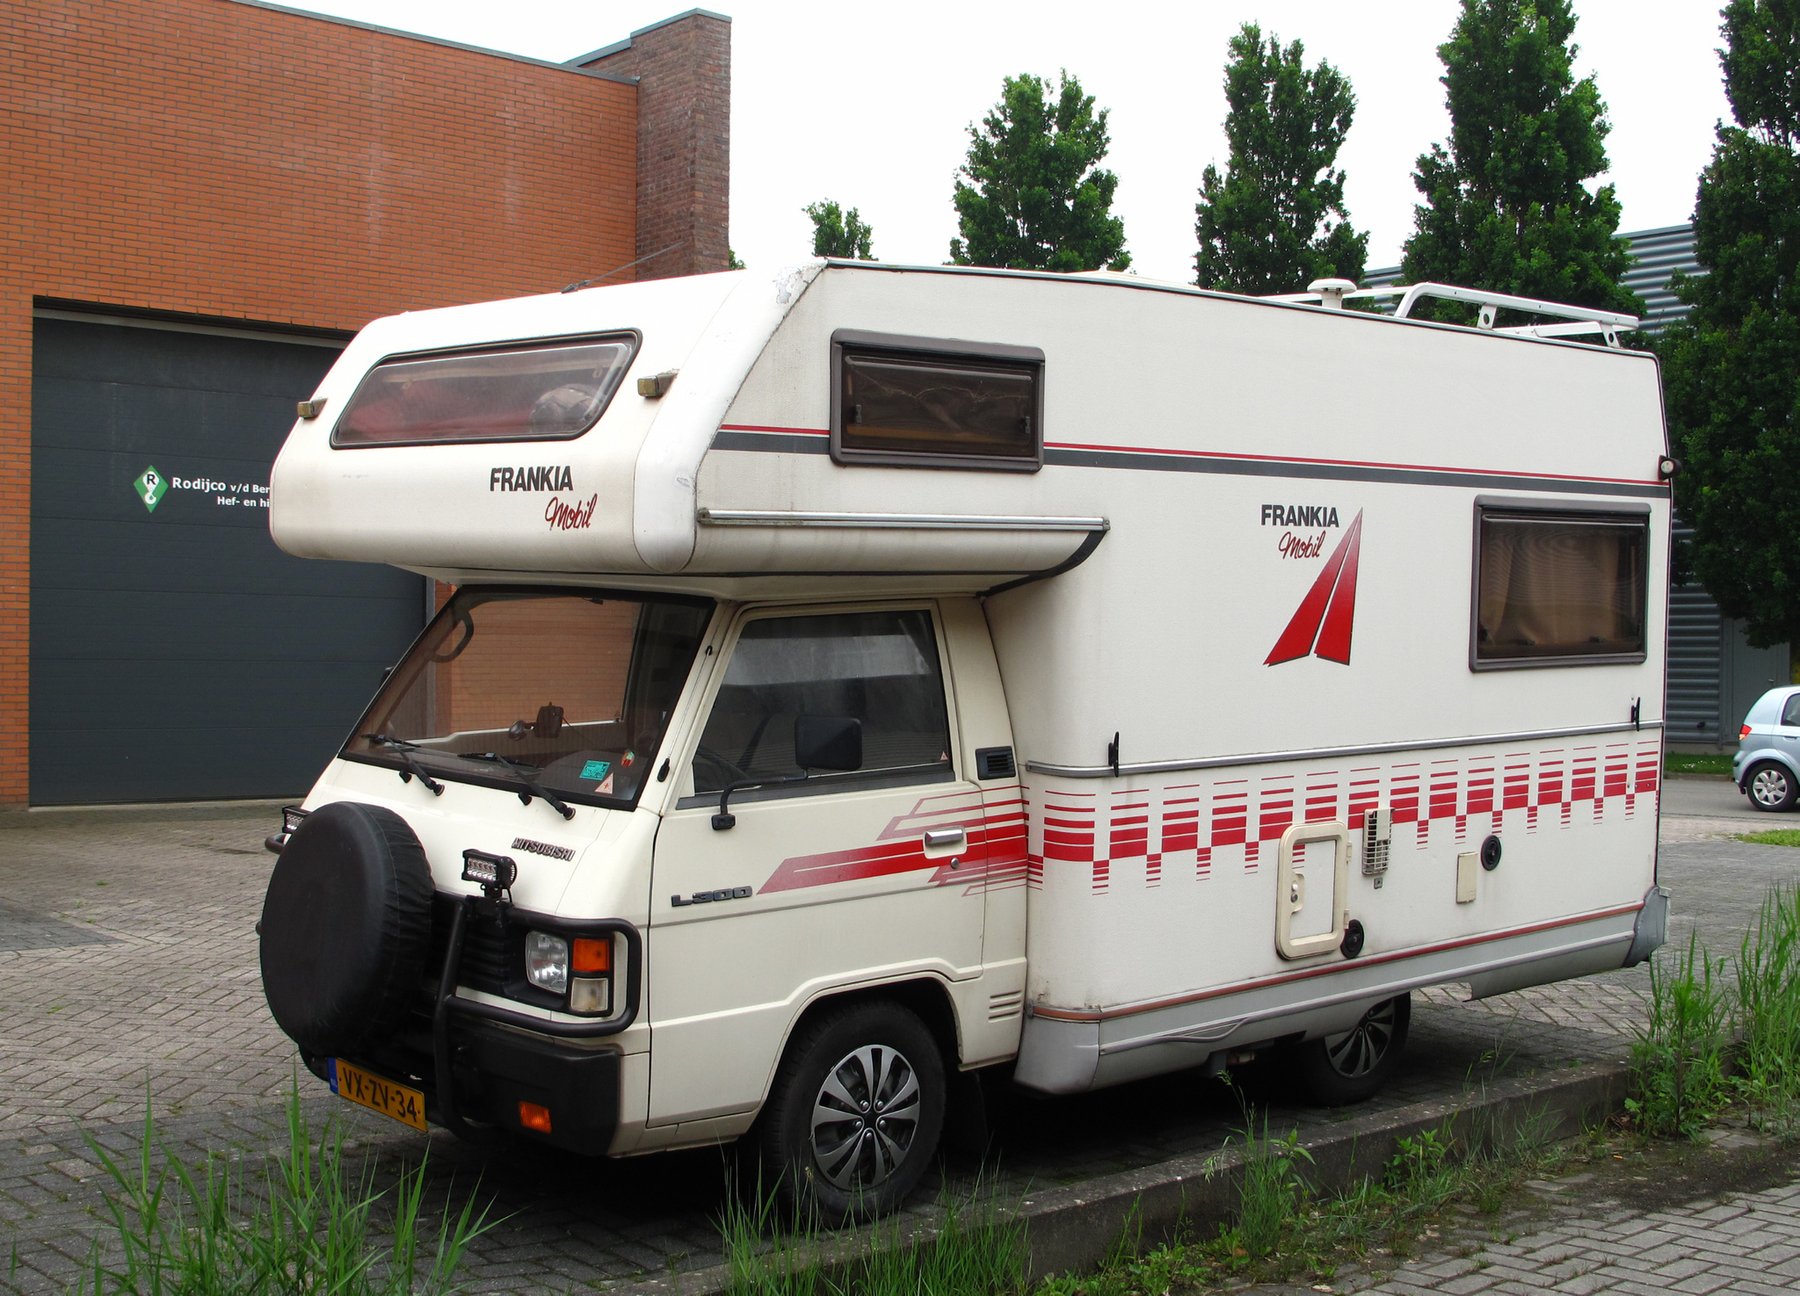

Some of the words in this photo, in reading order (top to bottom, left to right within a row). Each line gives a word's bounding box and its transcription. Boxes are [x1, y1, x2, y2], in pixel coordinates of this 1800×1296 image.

[146, 474, 156, 485] R
[172, 477, 226, 493] Rodijco
[230, 484, 249, 495] v/d
[490, 465, 574, 492] FRANKIA
[217, 496, 240, 507] Hef-
[243, 499, 257, 507] en
[545, 493, 598, 531] Mobil
[1261, 504, 1340, 528] FRANKIA
[1278, 530, 1326, 559] Mobil
[511, 836, 577, 862] MITSUBISHI
[342, 1066, 418, 1123] VX-ZV-34
